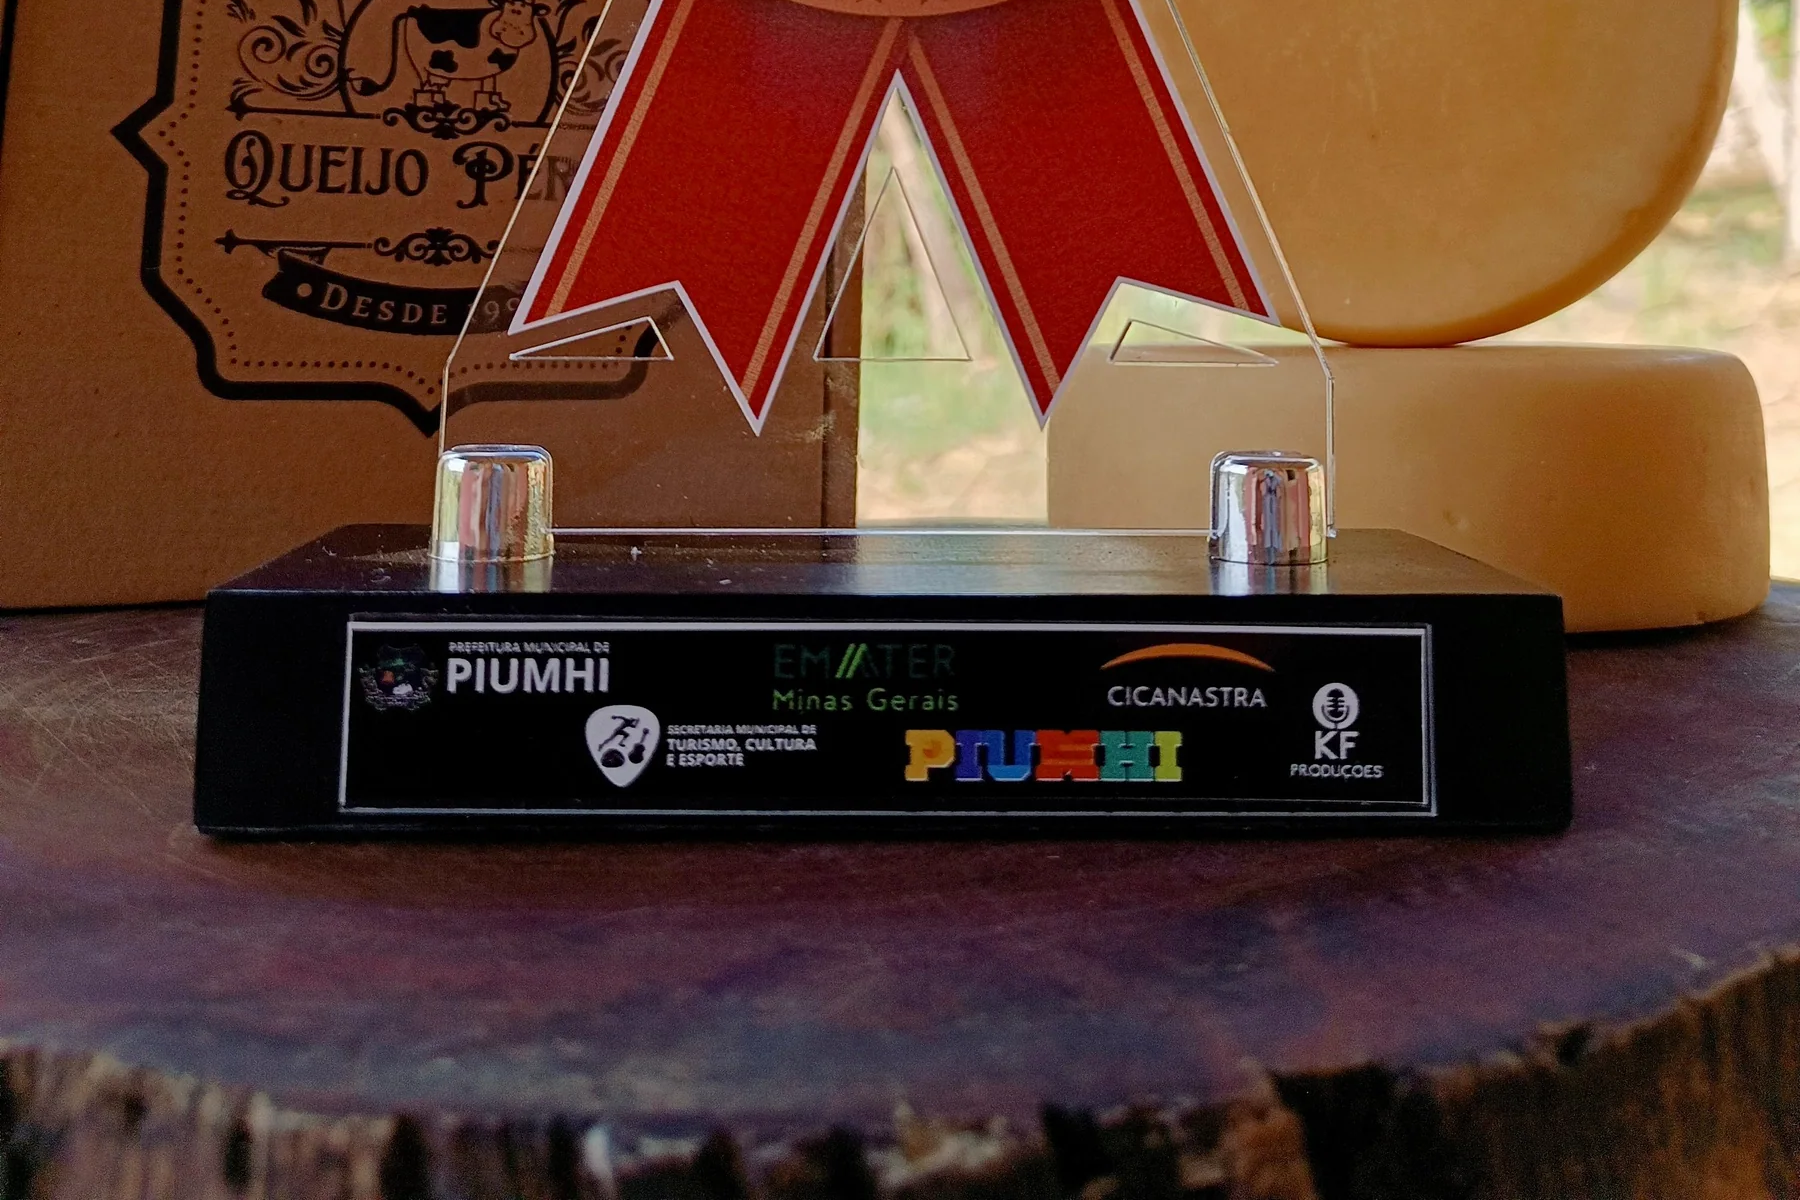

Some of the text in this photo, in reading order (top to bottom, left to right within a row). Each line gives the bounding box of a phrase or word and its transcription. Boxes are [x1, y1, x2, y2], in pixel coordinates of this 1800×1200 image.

[223, 129, 429, 208] QUEIJO
[319, 281, 448, 324] DESDE
[448, 641, 610, 654] PREFEITURA MUNICIPAL DE
[446, 657, 610, 694] PIUMHI
[772, 687, 960, 712] Minas Gerais
[1107, 685, 1268, 708] CICANASTRA
[667, 724, 817, 735] SECRETARIA MUNICIPAL DE
[744, 737, 818, 752] CULTURA
[1314, 730, 1360, 760] KF
[665, 752, 745, 768] E ESPORTE
